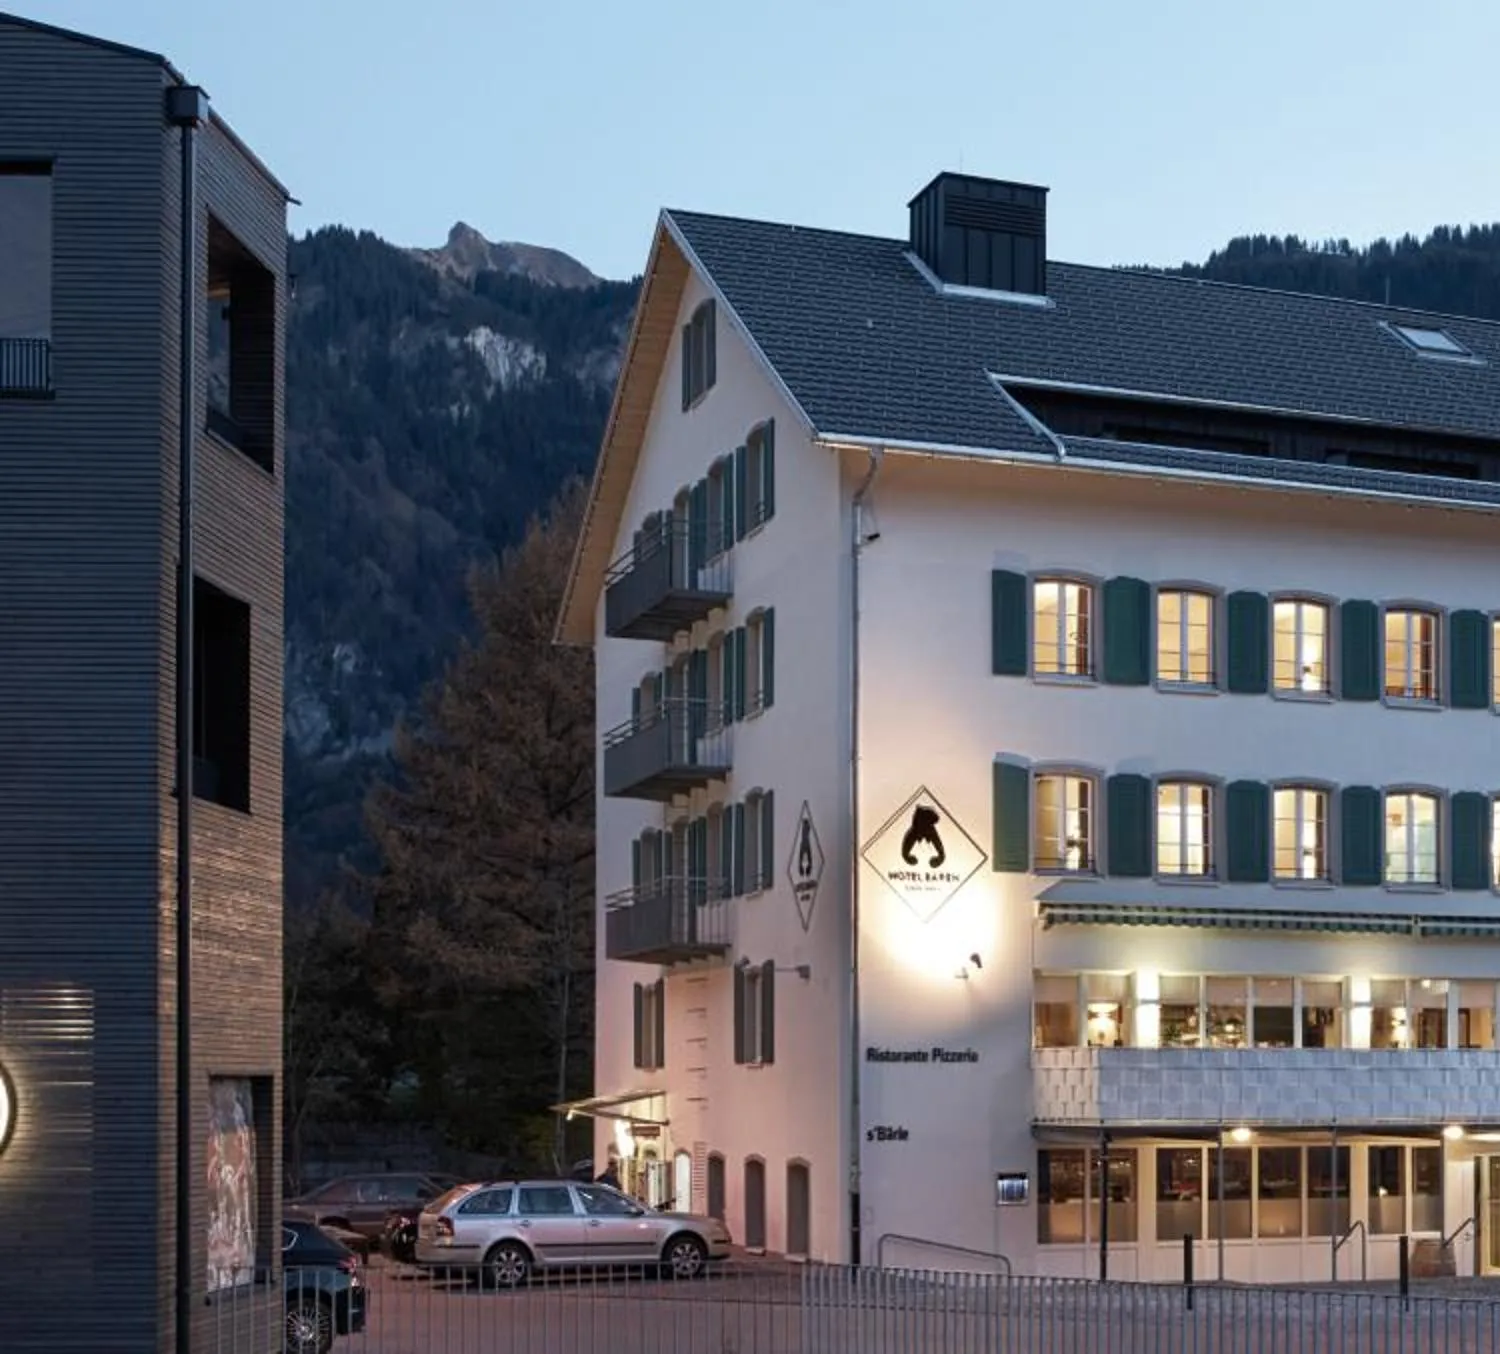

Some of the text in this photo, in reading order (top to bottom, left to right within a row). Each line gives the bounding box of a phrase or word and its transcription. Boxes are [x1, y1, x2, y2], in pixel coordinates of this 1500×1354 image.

[888, 871, 922, 881] HOTEL
[866, 1047, 979, 1062] Ristorante Pizzeria
